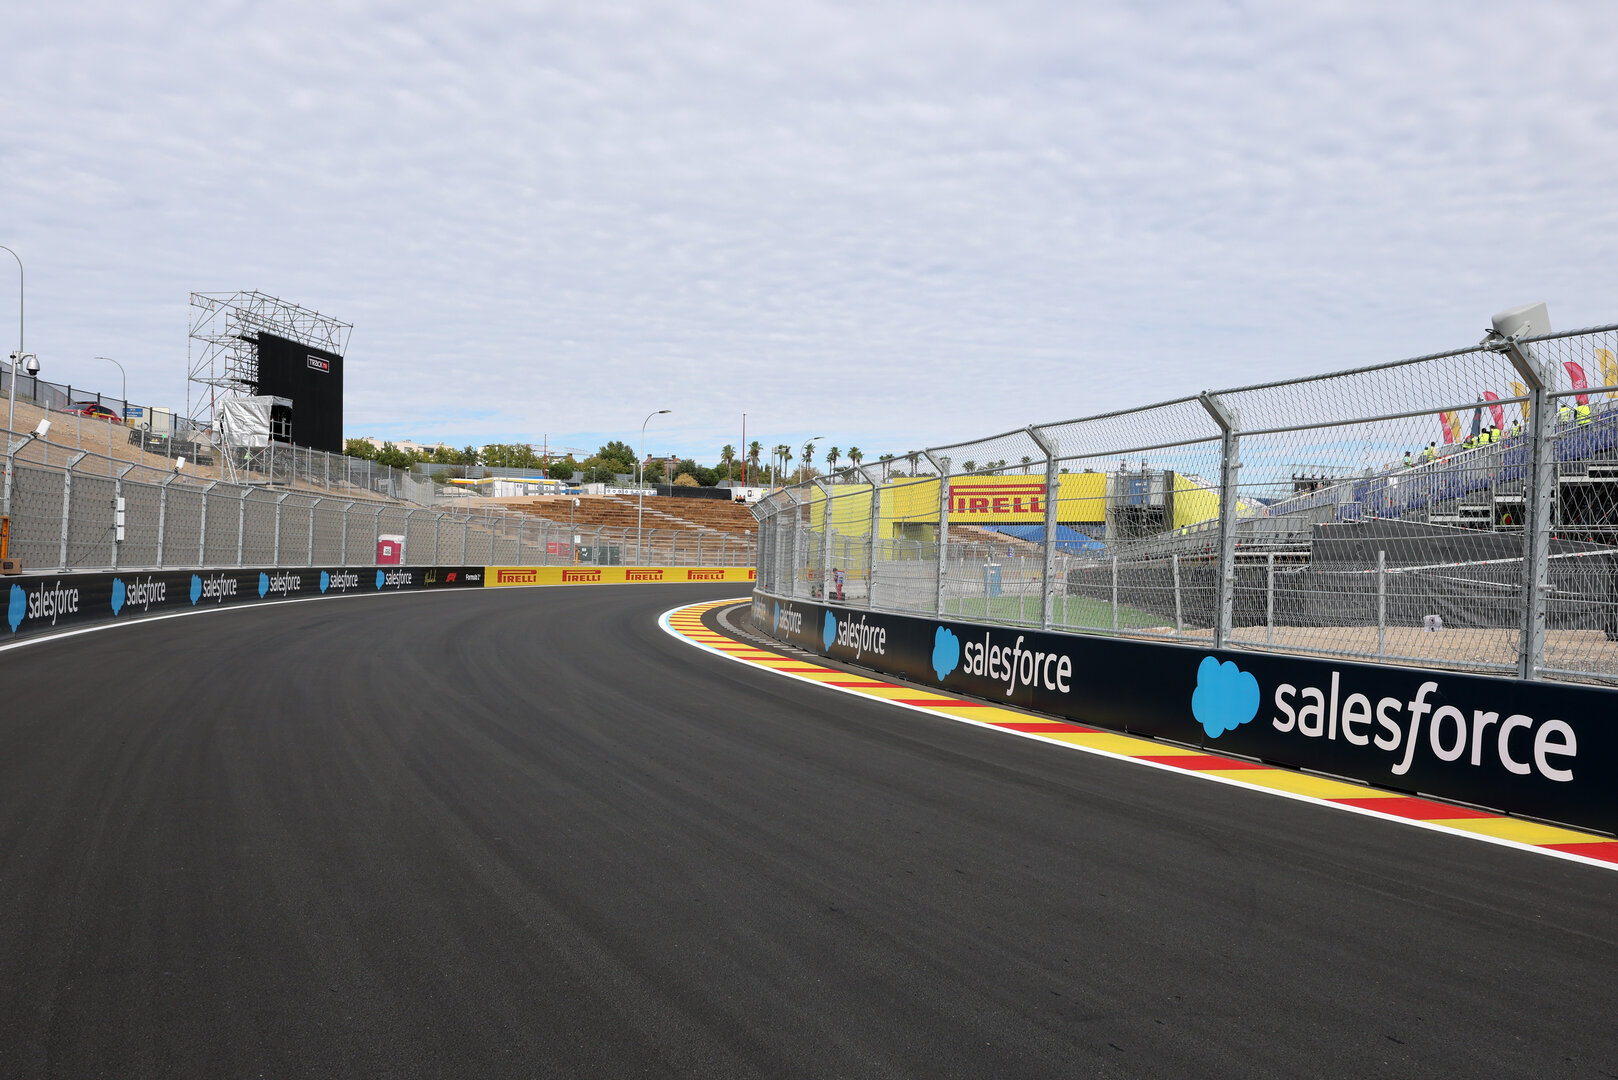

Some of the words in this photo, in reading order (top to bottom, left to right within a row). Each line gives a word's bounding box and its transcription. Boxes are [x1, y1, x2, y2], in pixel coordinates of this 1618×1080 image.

[949, 483, 1047, 513] PIRELL
[203, 573, 237, 603] salesforce
[269, 571, 301, 597] salesforce
[329, 569, 359, 592] salesforce
[385, 569, 412, 589] salesforce
[497, 569, 537, 583] PIRELLI
[562, 569, 601, 582] PIRELLI
[625, 569, 663, 581] PIRELLI
[687, 569, 725, 580] PIRELLI
[28, 580, 79, 626] salesforce
[127, 575, 166, 611] salesforce
[779, 603, 802, 638] salesforce
[837, 613, 886, 660] salesforce
[963, 631, 1072, 696] salesforce
[1272, 671, 1577, 782] salesforce
